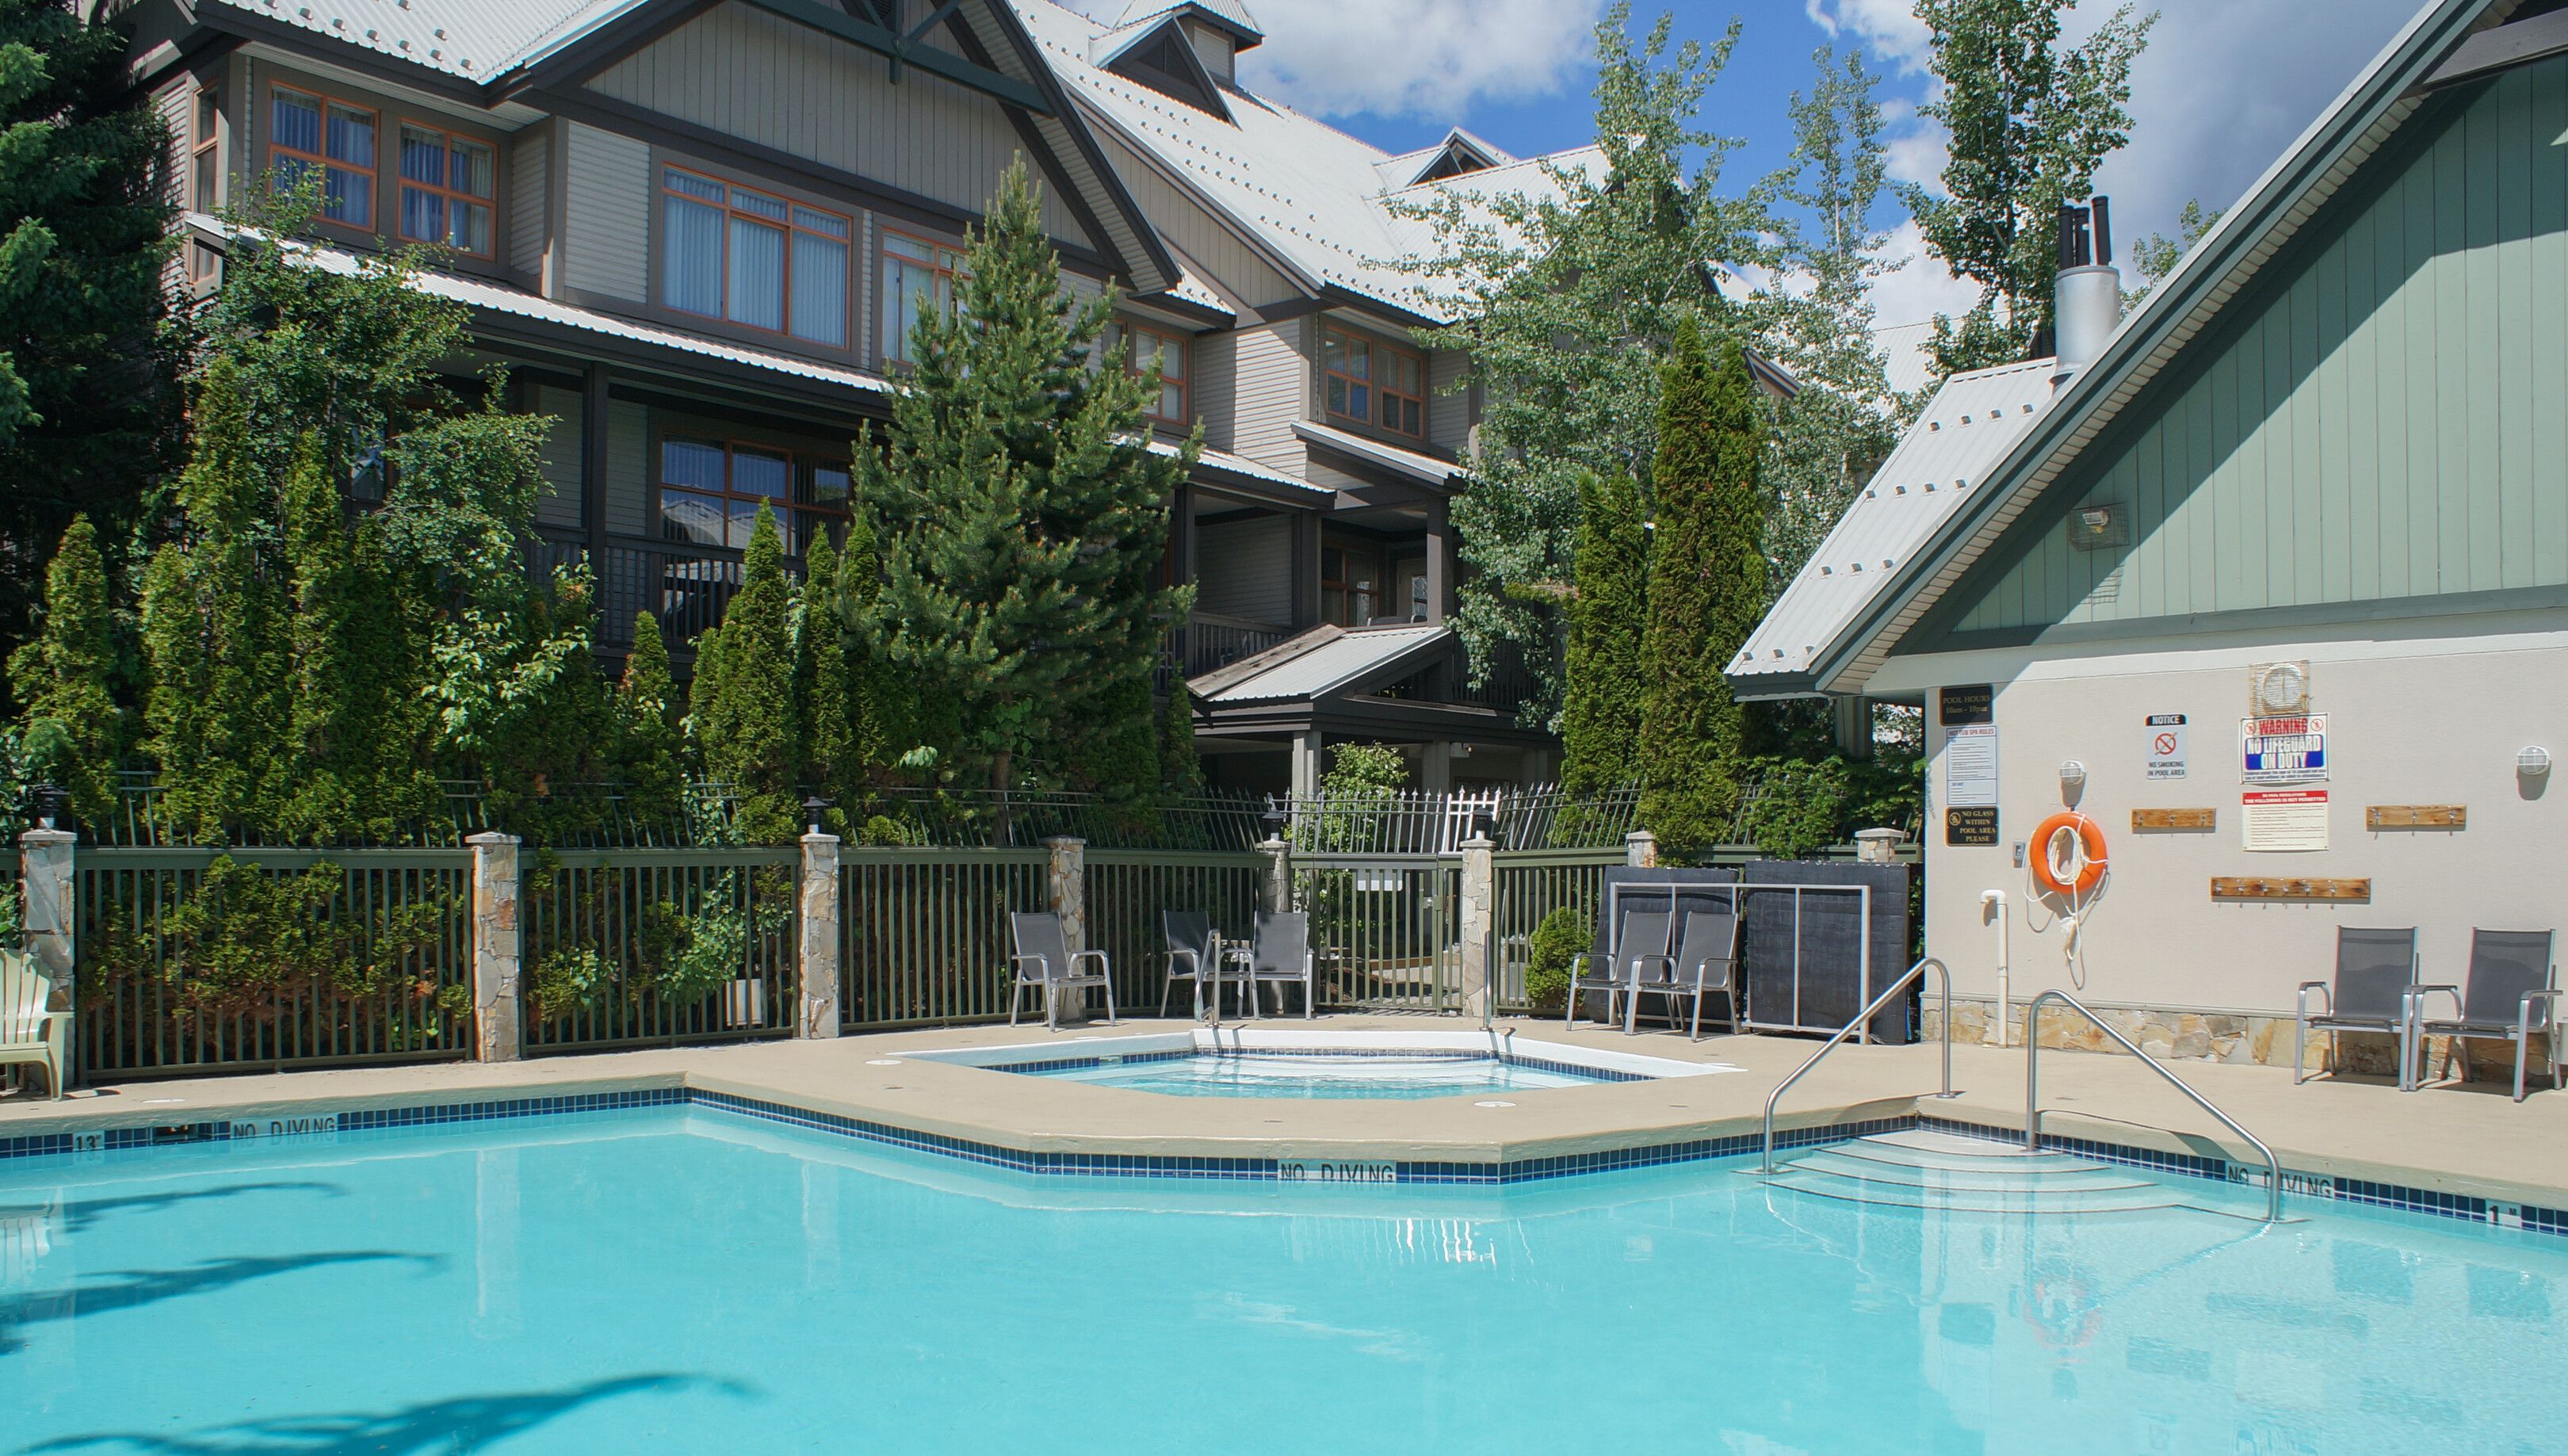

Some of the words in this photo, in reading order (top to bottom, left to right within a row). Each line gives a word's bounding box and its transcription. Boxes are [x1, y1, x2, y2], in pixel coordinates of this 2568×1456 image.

[1964, 694, 1990, 703] HOURS
[2152, 715, 2180, 725] NOTICE
[2258, 717, 2308, 736] WARNING
[2246, 737, 2262, 755] NO
[2263, 735, 2322, 754] LIFEGUARD
[2260, 753, 2276, 770] ON
[2277, 751, 2307, 769] DUTY
[234, 1123, 256, 1138] NO
[270, 1117, 335, 1135] DIVING
[1281, 1163, 1305, 1179] NO
[1320, 1164, 1393, 1182] DIVING
[2228, 1165, 2249, 1181] NO
